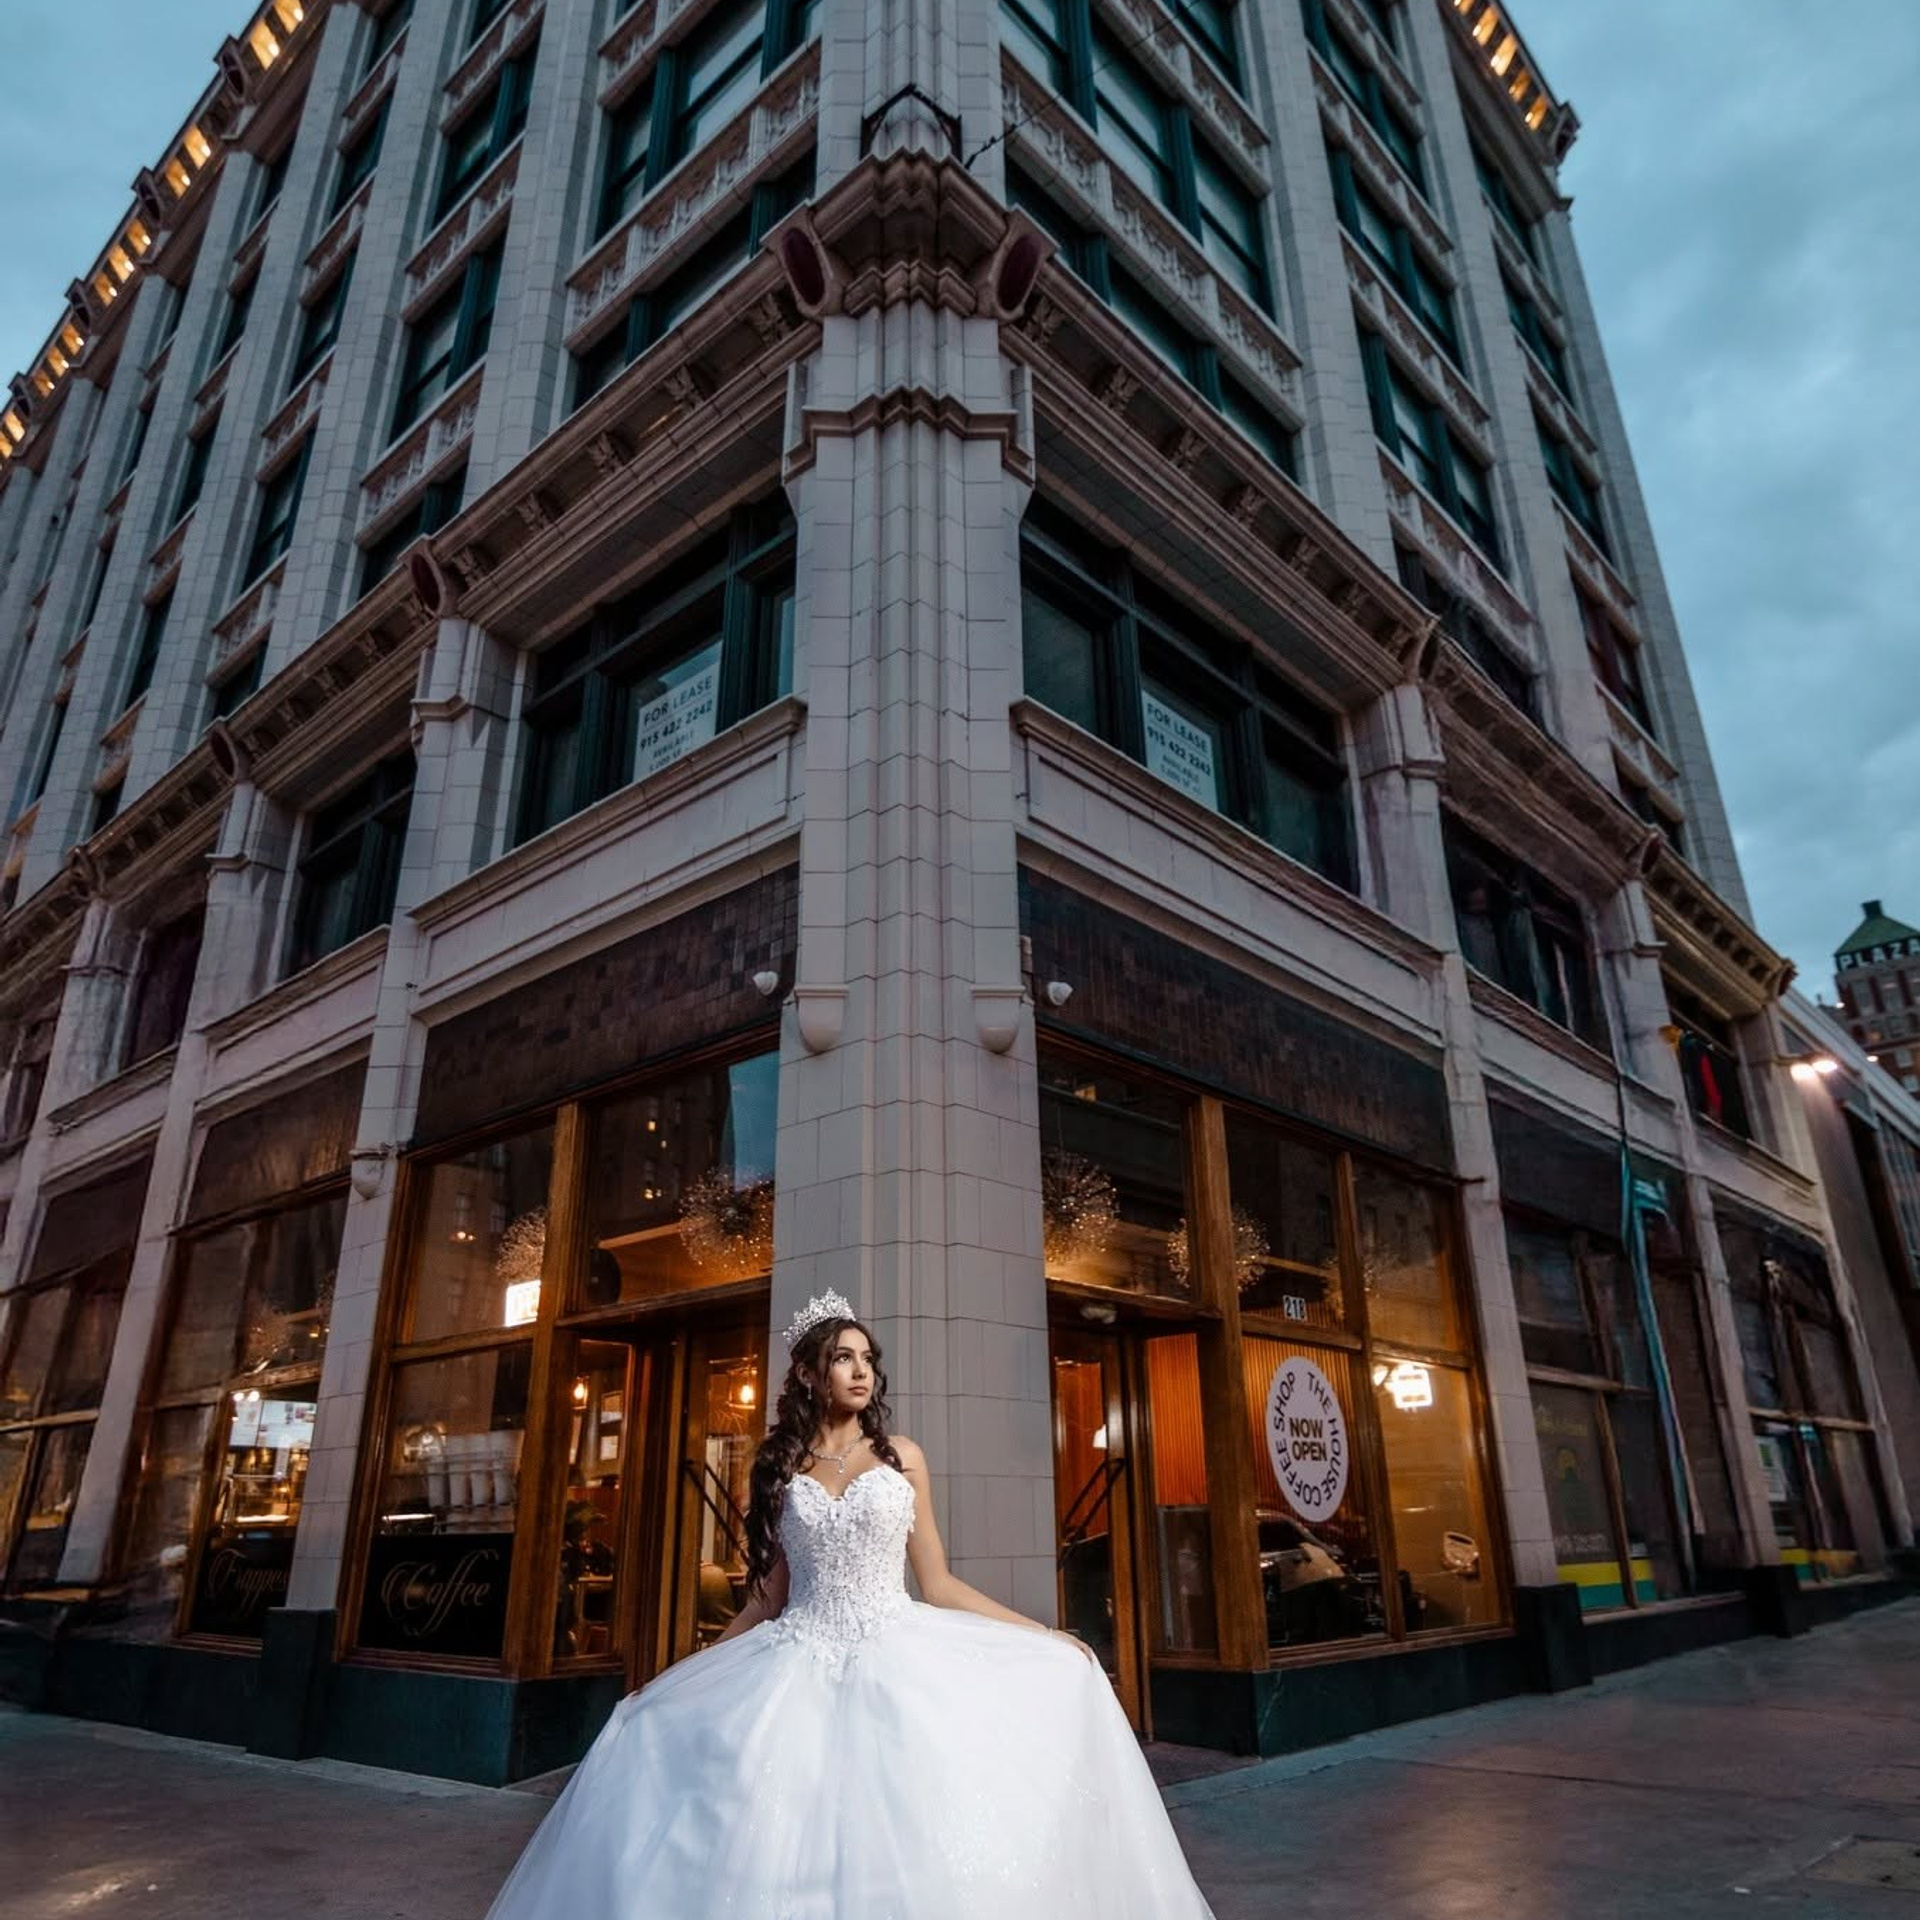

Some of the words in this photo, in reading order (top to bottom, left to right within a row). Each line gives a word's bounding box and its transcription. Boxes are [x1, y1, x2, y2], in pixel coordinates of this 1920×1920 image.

[644, 703, 668, 726] FOR
[672, 675, 713, 709] LEASE
[640, 730, 659, 750] 915
[1147, 703, 1170, 725] FOR
[1174, 723, 1208, 754] LEASE
[1147, 726, 1166, 747] 915
[1838, 937, 1920, 974] PLAZA
[1273, 1371, 1296, 1432] SHOP
[1307, 1372, 1334, 1414] THE
[1289, 1417, 1324, 1438] NOW
[1275, 1439, 1322, 1507] COFFEE
[1291, 1440, 1328, 1462] OPEN
[1321, 1418, 1342, 1501] HOUSE
[381, 1548, 500, 1637] Coffee
